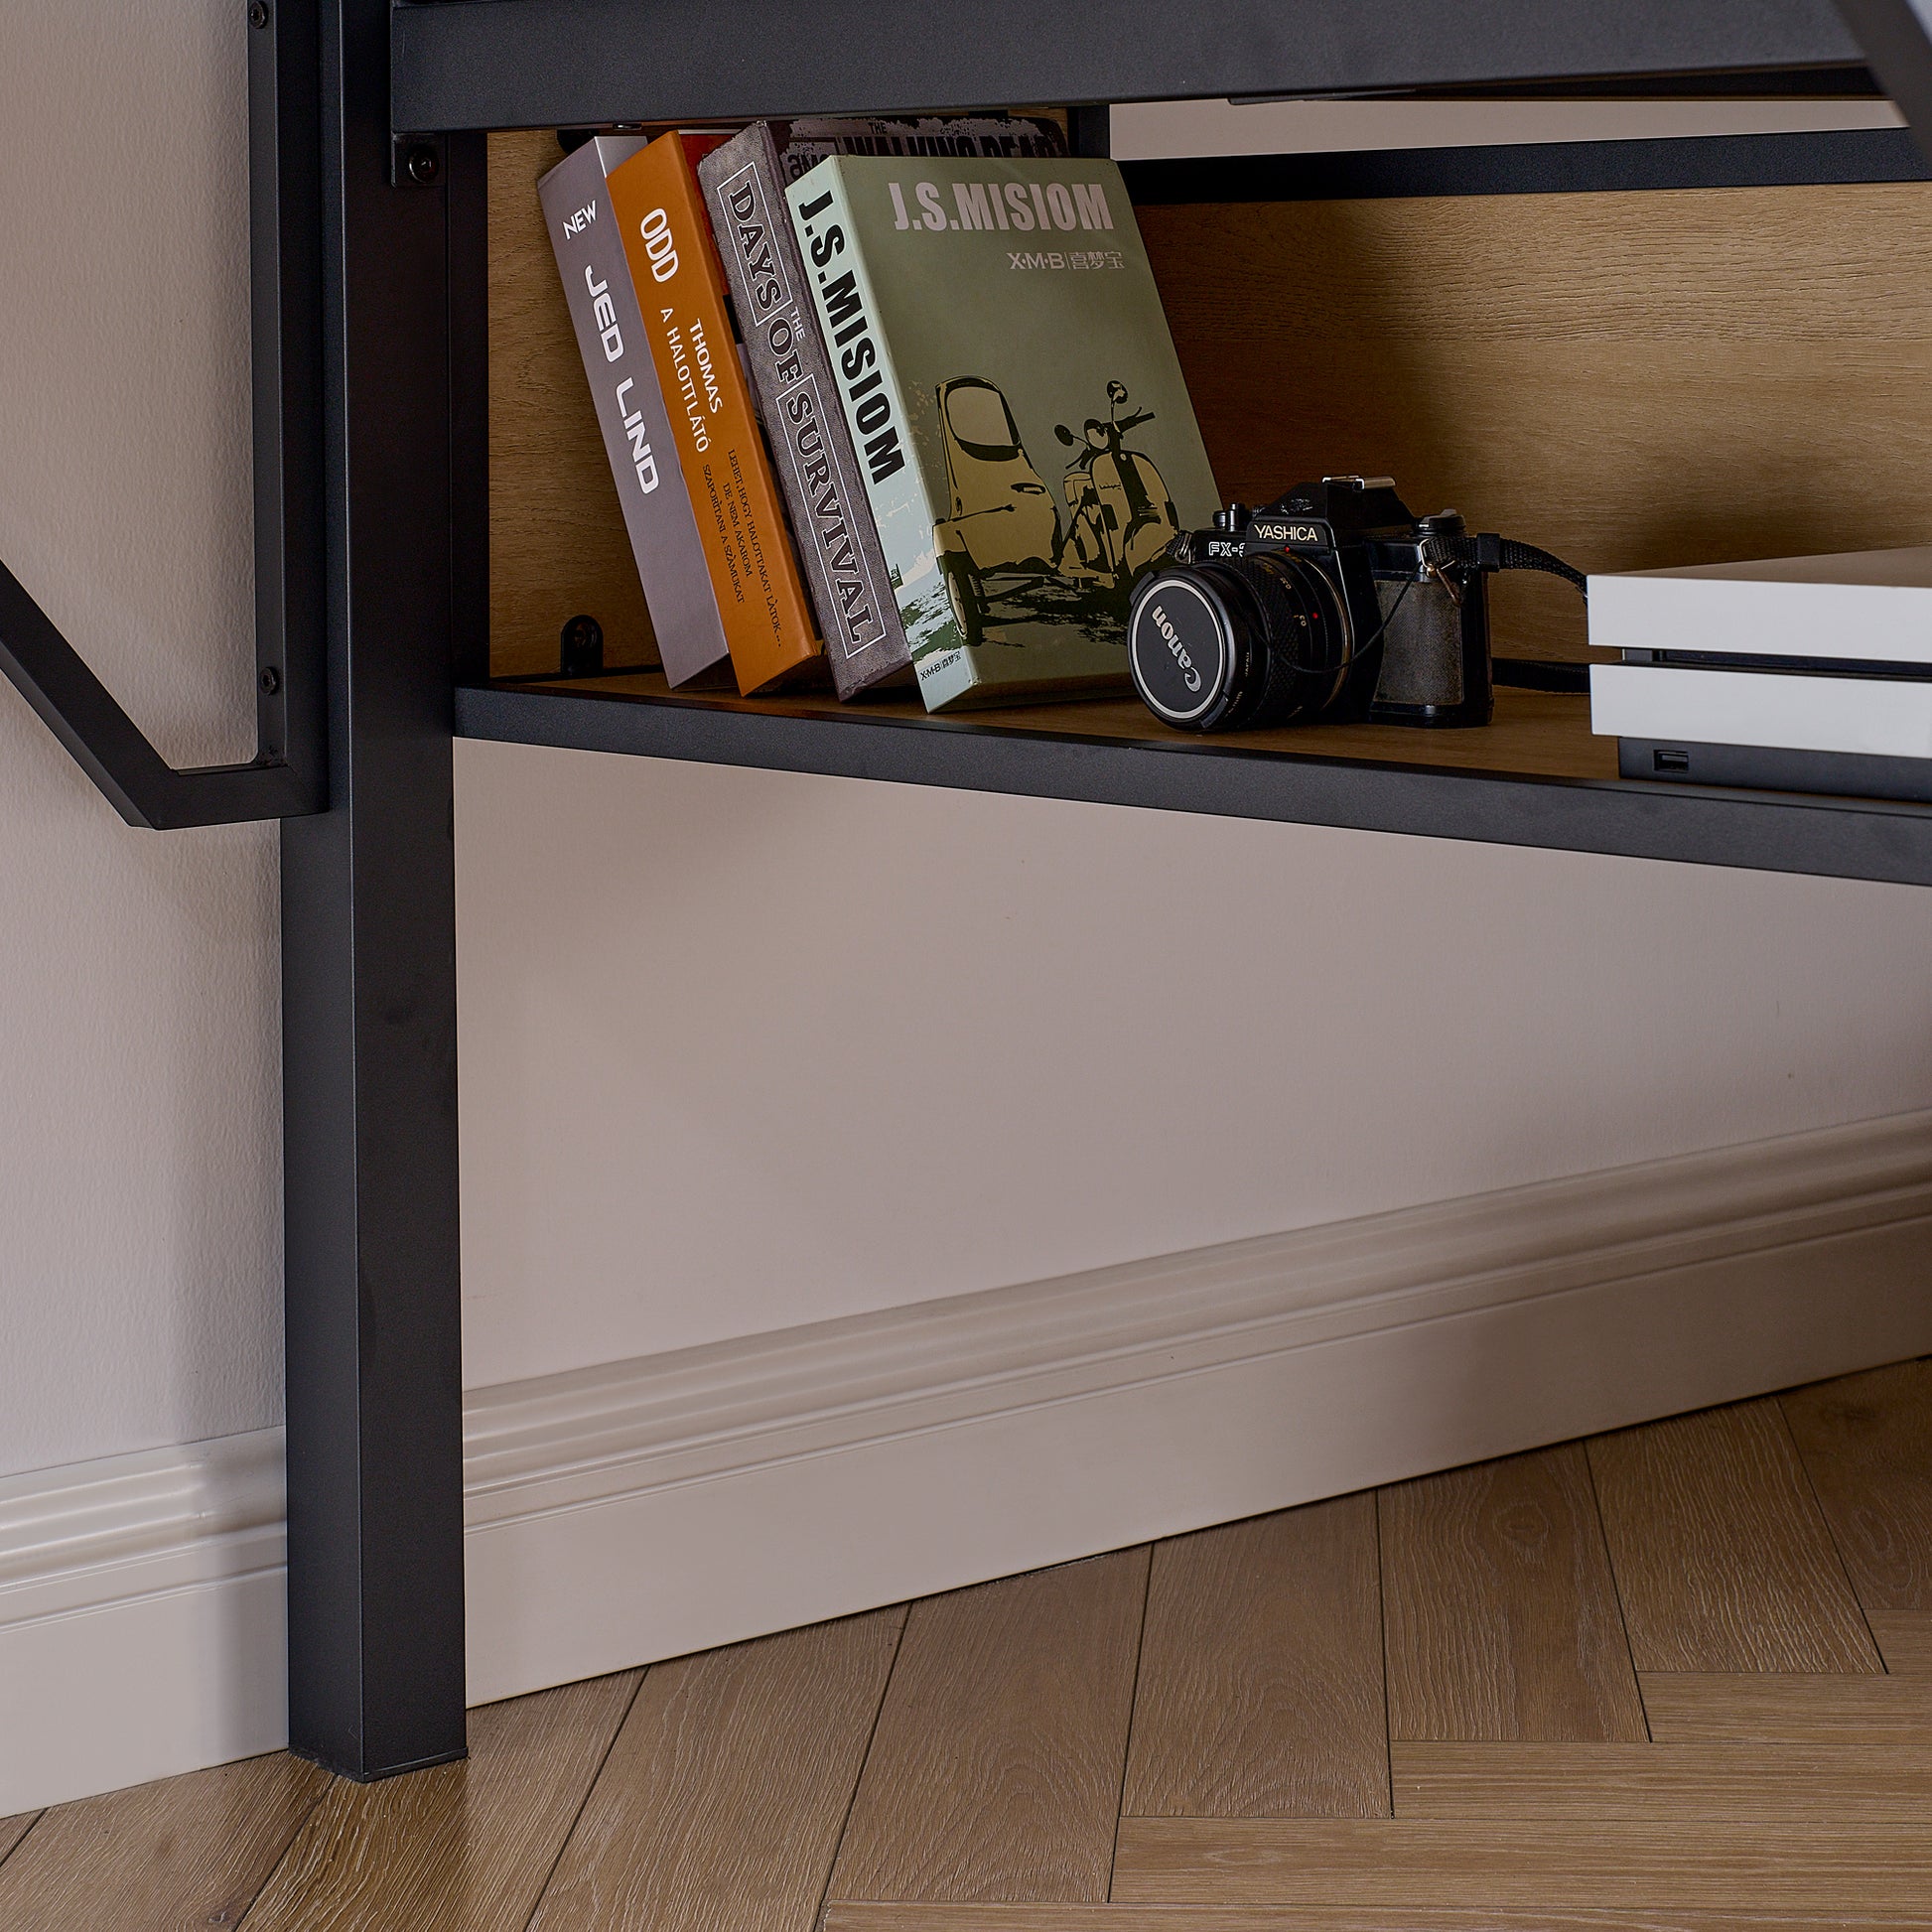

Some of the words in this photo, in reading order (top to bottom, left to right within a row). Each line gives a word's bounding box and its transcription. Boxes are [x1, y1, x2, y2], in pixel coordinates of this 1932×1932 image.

[868, 122, 888, 135] THE
[562, 201, 597, 240] NEW
[888, 182, 1114, 232] J.S.MISIOM
[640, 207, 679, 283] ODD
[728, 182, 782, 312] DAYS
[767, 317, 803, 384] OF
[660, 308, 672, 324] A
[790, 306, 805, 342] THE
[799, 189, 905, 485] J.S.MISIOM
[585, 264, 624, 363] JED
[616, 377, 660, 494] LIND
[689, 318, 724, 414] THOMAS
[723, 483, 734, 500] DE
[728, 500, 741, 527] NEM
[721, 535, 729, 544] A
[786, 391, 874, 645] SURVIVAL
[1254, 524, 1318, 542] YASHICA
[735, 529, 754, 578] AKAROM
[747, 520, 772, 593] HALOTTAKAT
[1152, 605, 1202, 693] Canon
